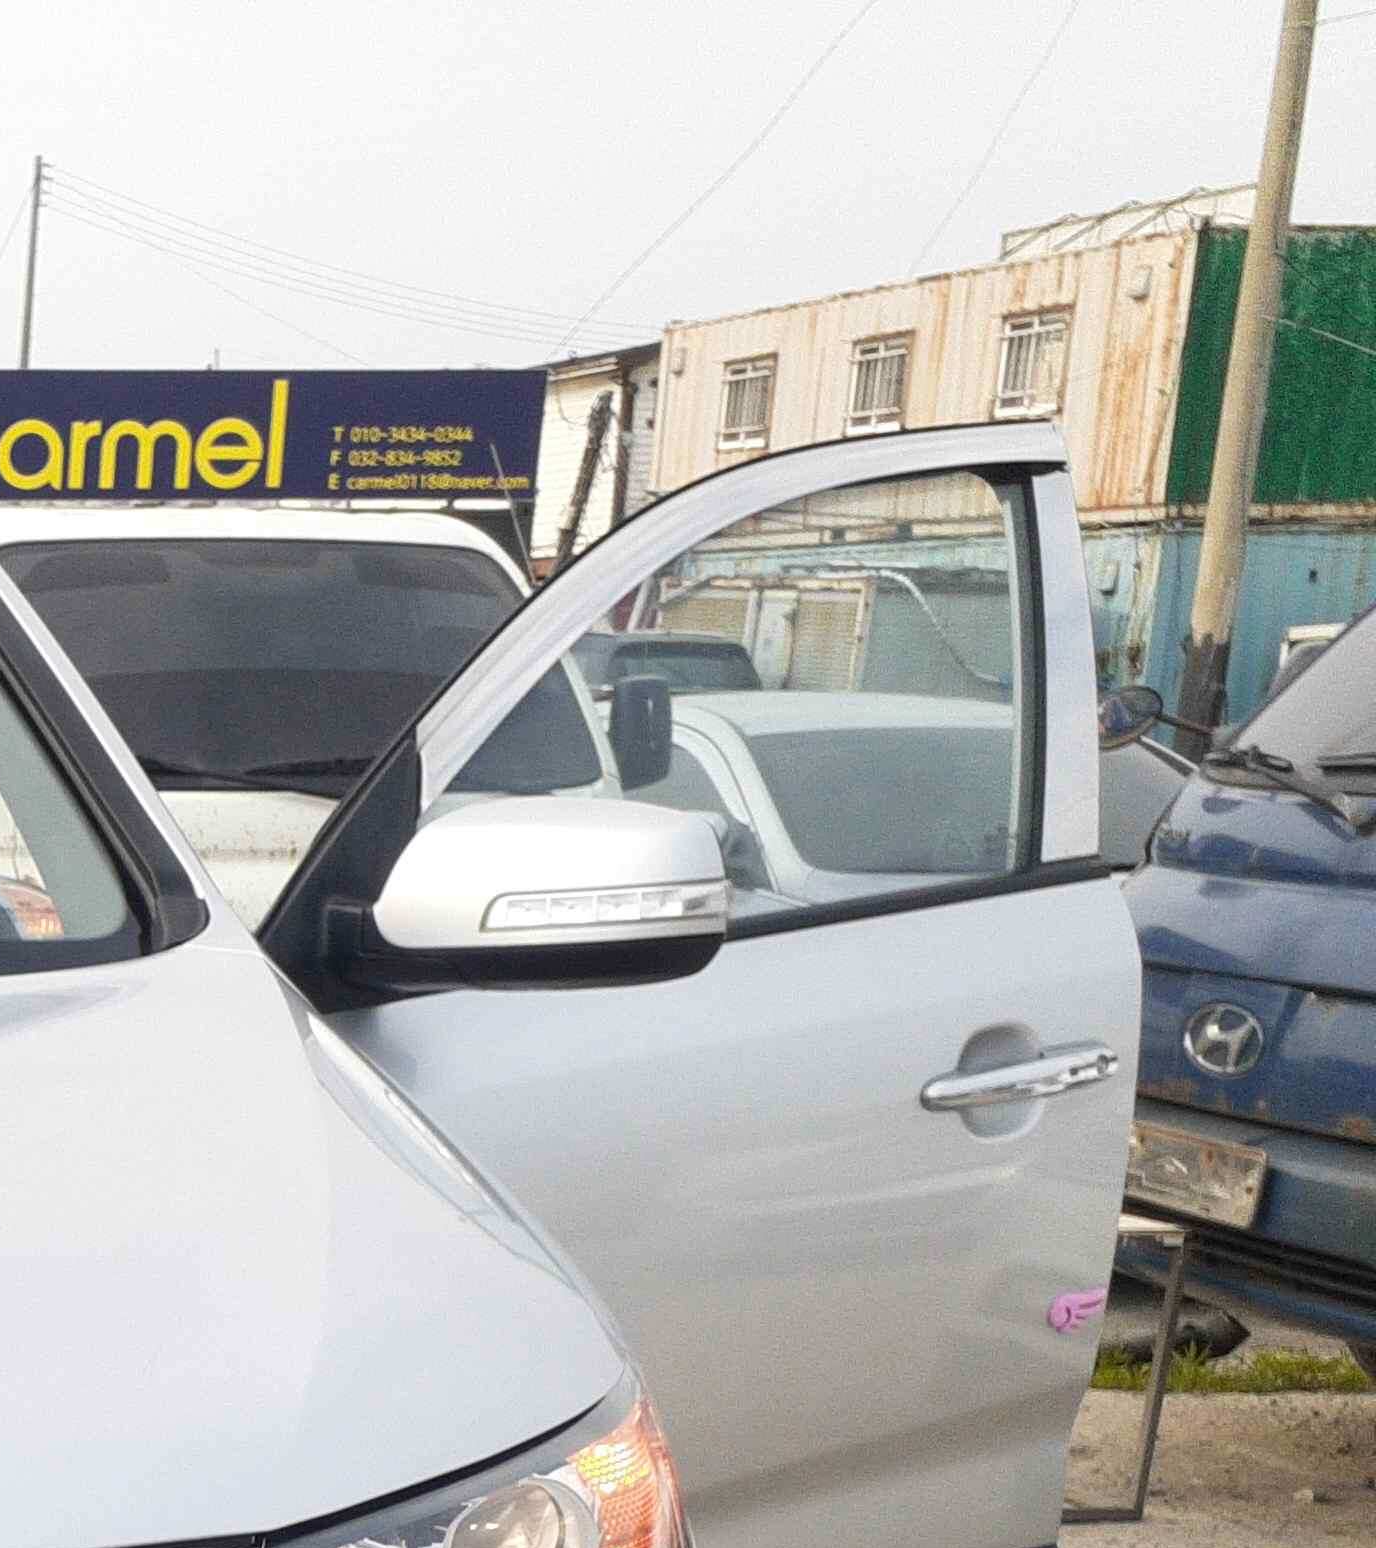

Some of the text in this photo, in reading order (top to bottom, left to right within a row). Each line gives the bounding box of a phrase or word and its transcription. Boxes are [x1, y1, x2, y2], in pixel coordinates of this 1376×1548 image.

[333, 426, 345, 443] T
[329, 450, 342, 466] F
[327, 473, 340, 490] E
